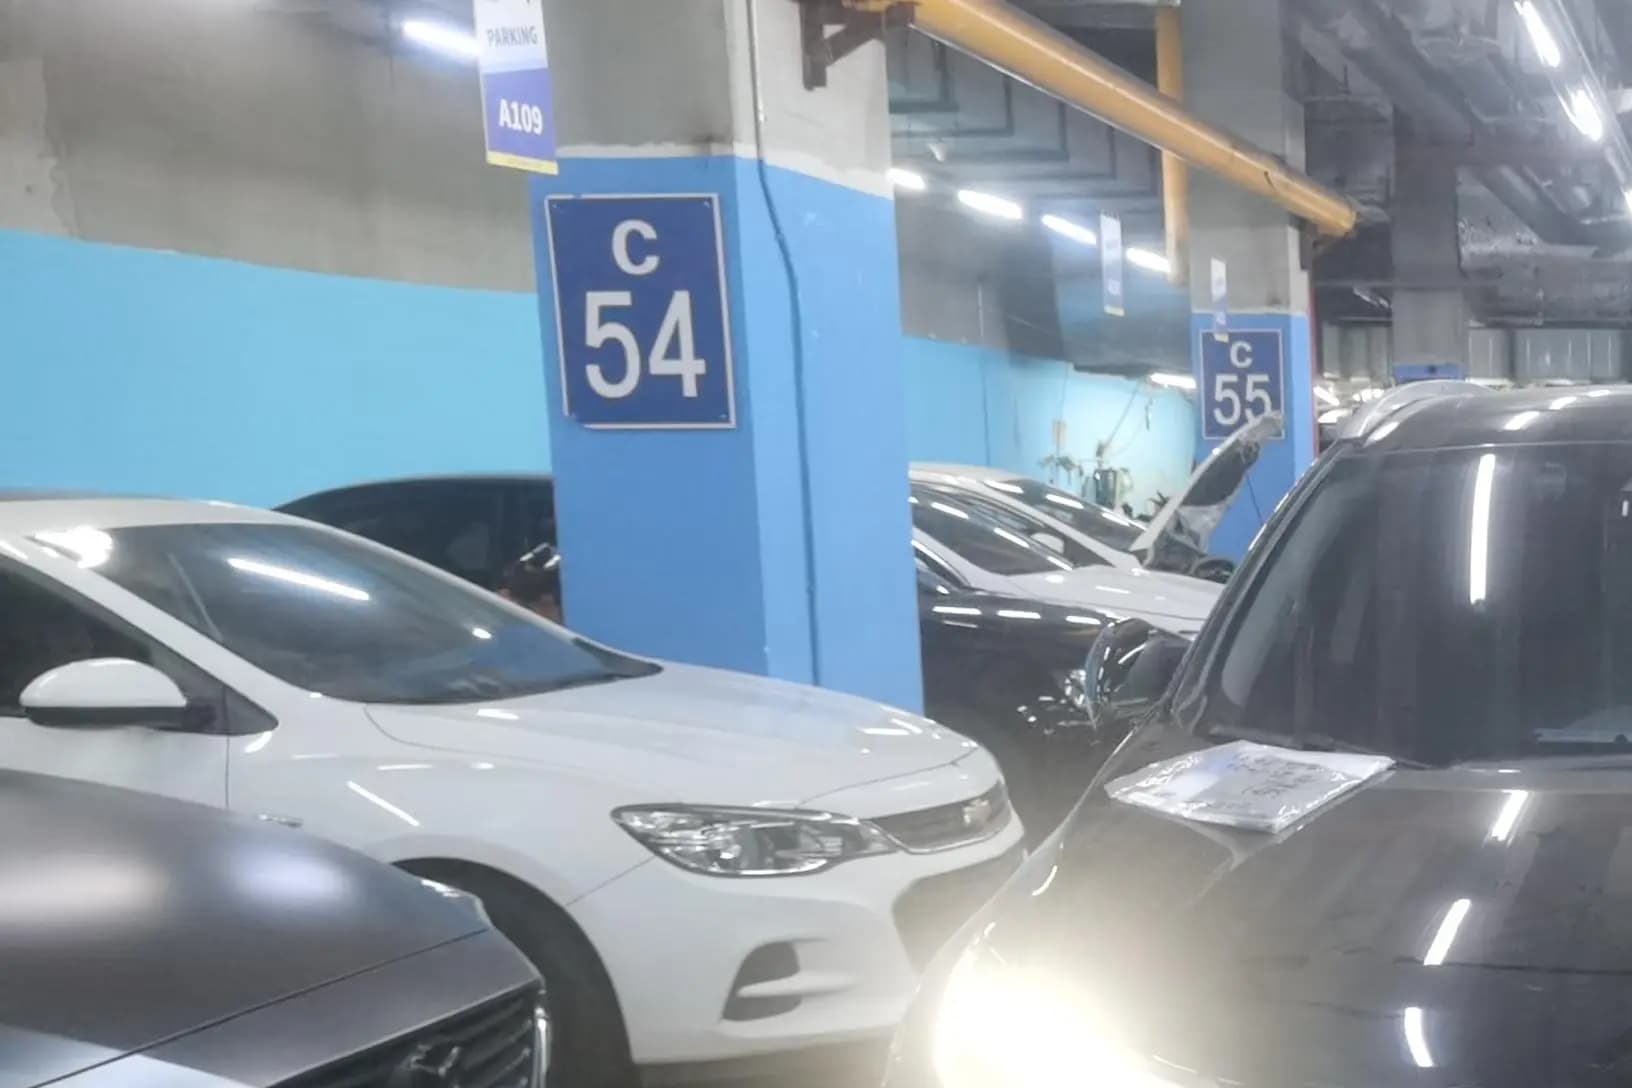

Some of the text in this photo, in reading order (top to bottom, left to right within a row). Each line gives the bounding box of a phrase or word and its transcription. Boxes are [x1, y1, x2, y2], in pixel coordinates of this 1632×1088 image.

[487, 26, 538, 47] PARKING
[499, 98, 543, 135] A109
[611, 219, 660, 276] C
[584, 289, 706, 399] 54
[1230, 341, 1253, 368] C
[1213, 374, 1272, 426] 55
